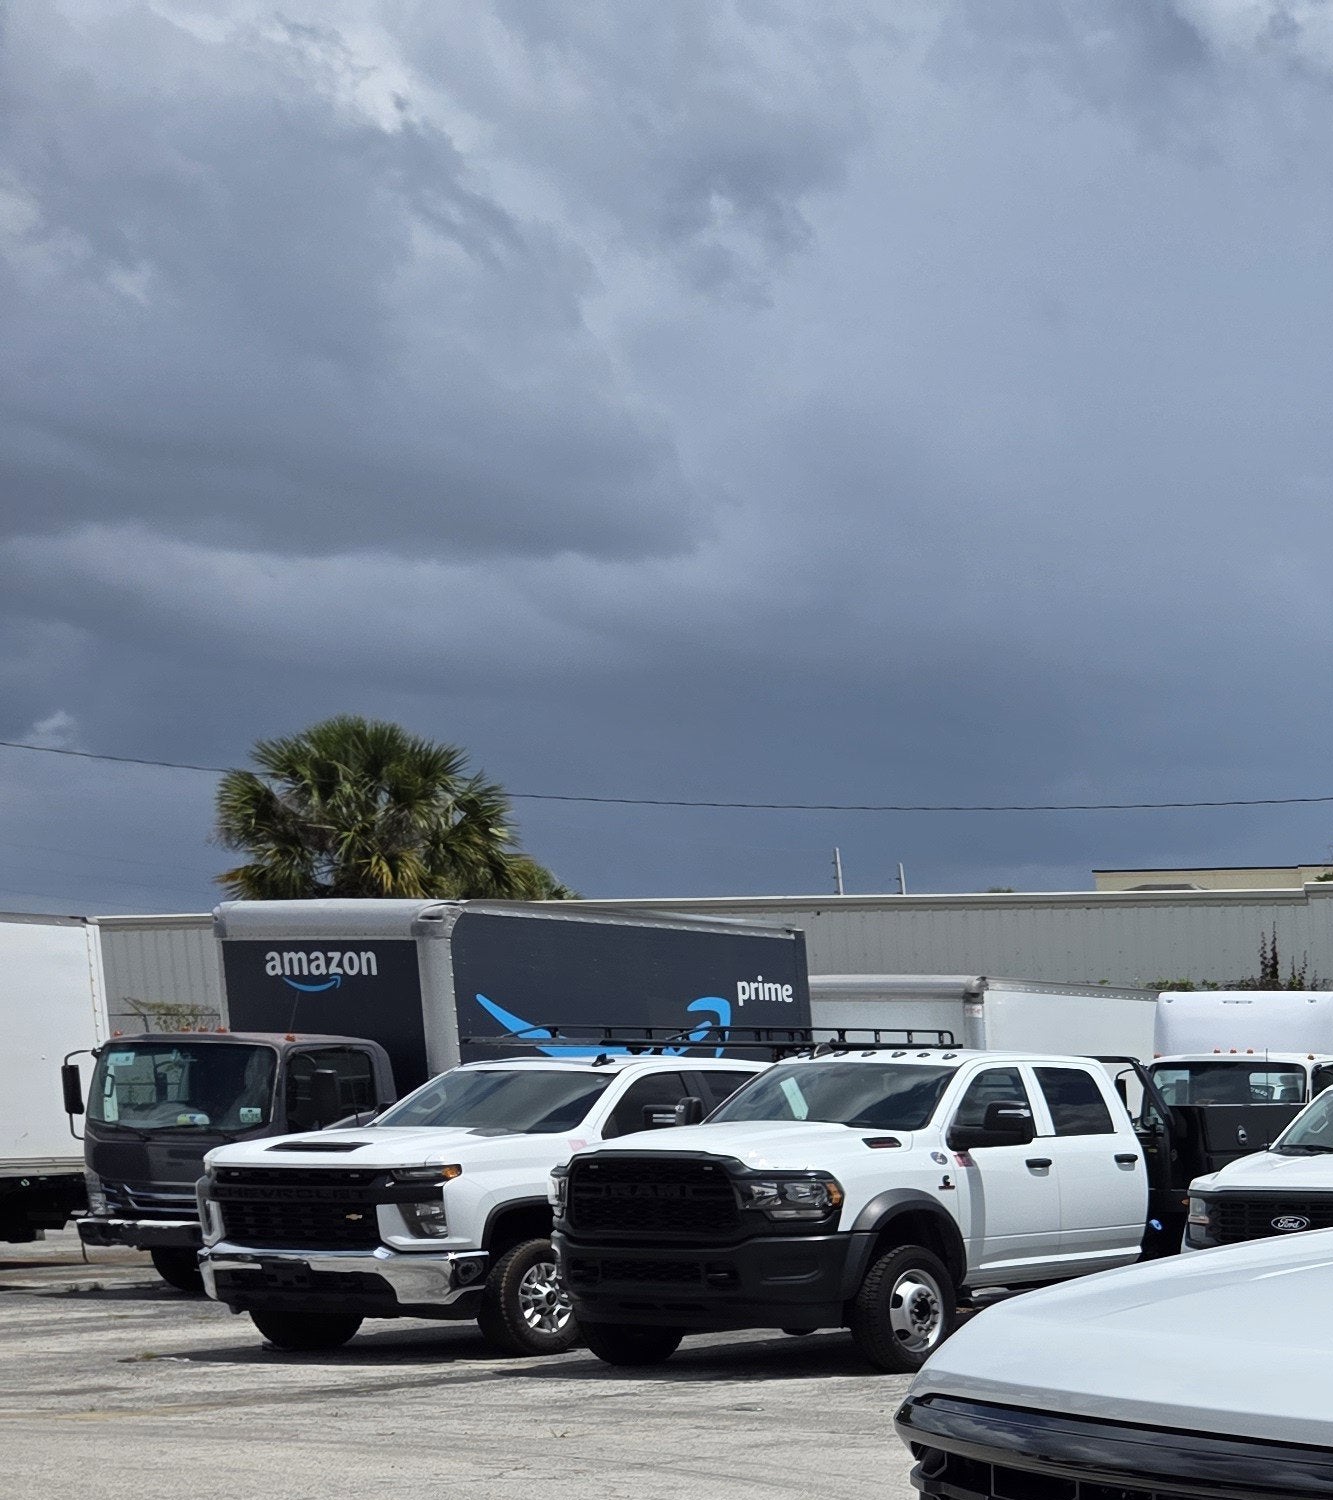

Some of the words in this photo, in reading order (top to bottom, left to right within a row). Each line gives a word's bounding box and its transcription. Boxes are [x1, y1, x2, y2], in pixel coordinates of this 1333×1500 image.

[265, 951, 378, 976] amazon
[737, 975, 793, 1006] prime
[1277, 1218, 1301, 1228] Ford
